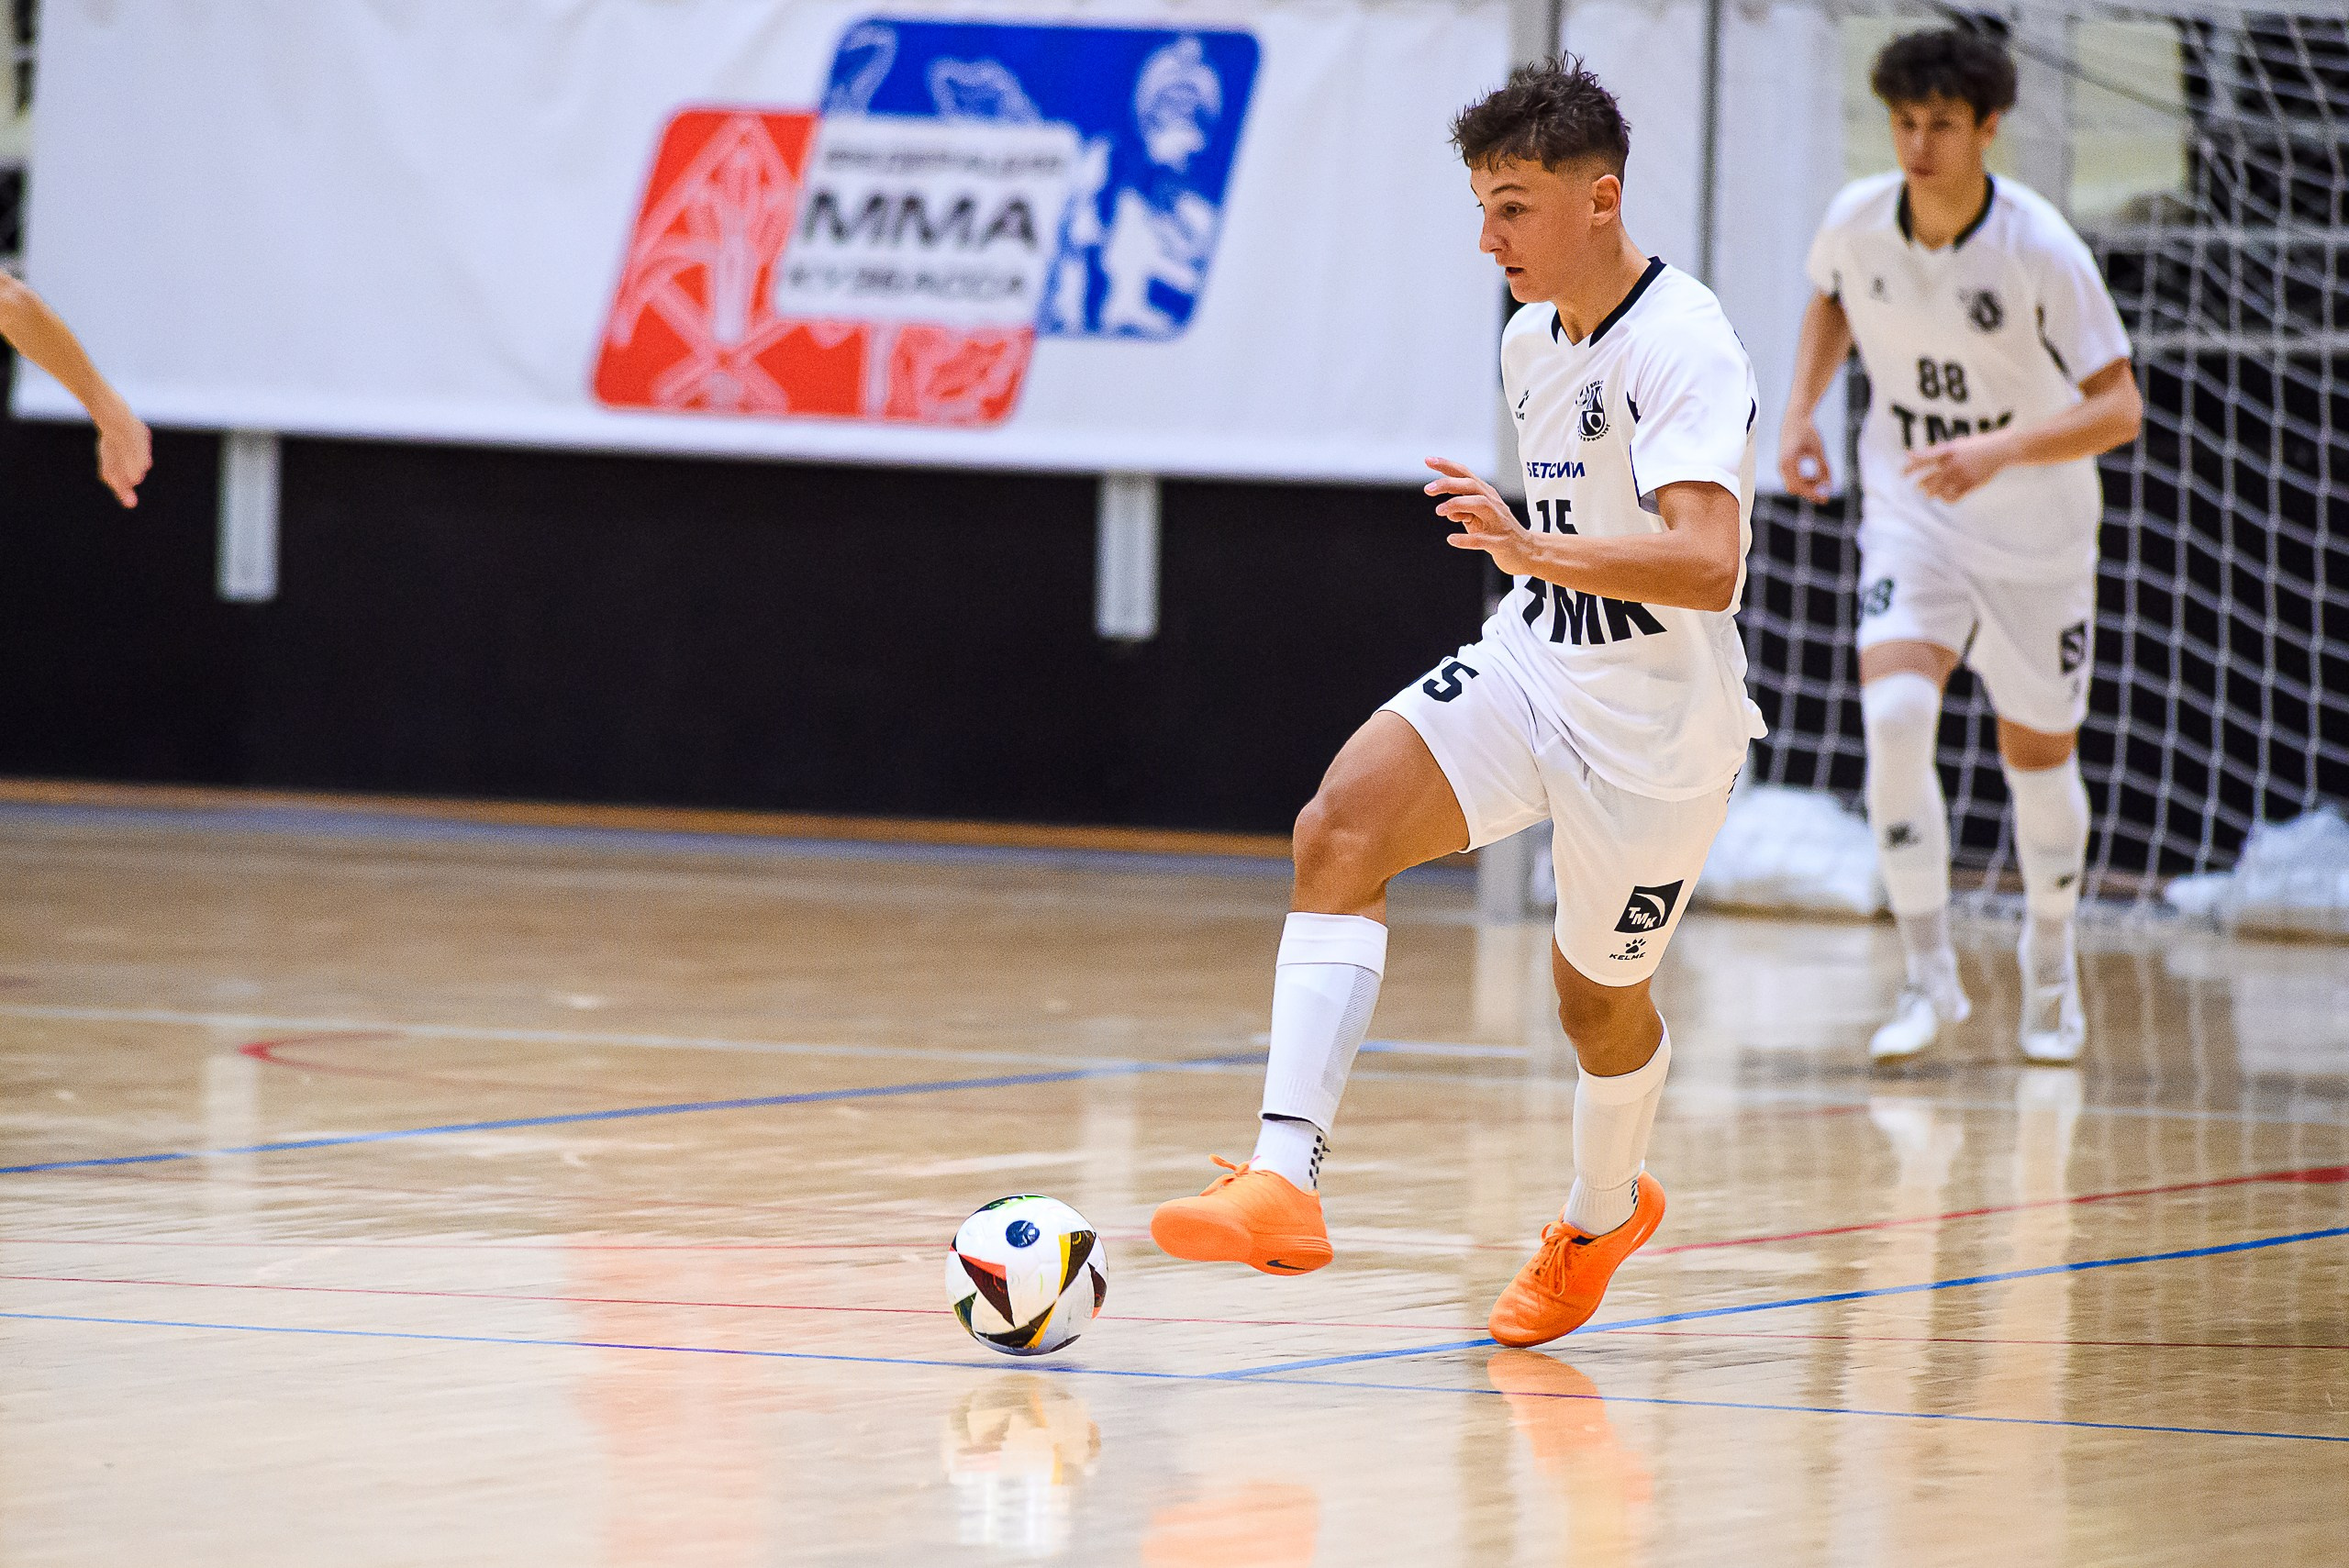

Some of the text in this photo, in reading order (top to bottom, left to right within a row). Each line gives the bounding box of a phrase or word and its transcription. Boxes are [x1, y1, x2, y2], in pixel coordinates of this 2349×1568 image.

[802, 188, 1040, 250] ММА
[1918, 355, 1968, 402] 88
[1536, 498, 1578, 535] 15
[1408, 661, 1480, 703] 5
[1629, 906, 1658, 929] ТМК
[1609, 951, 1646, 960] KELME
